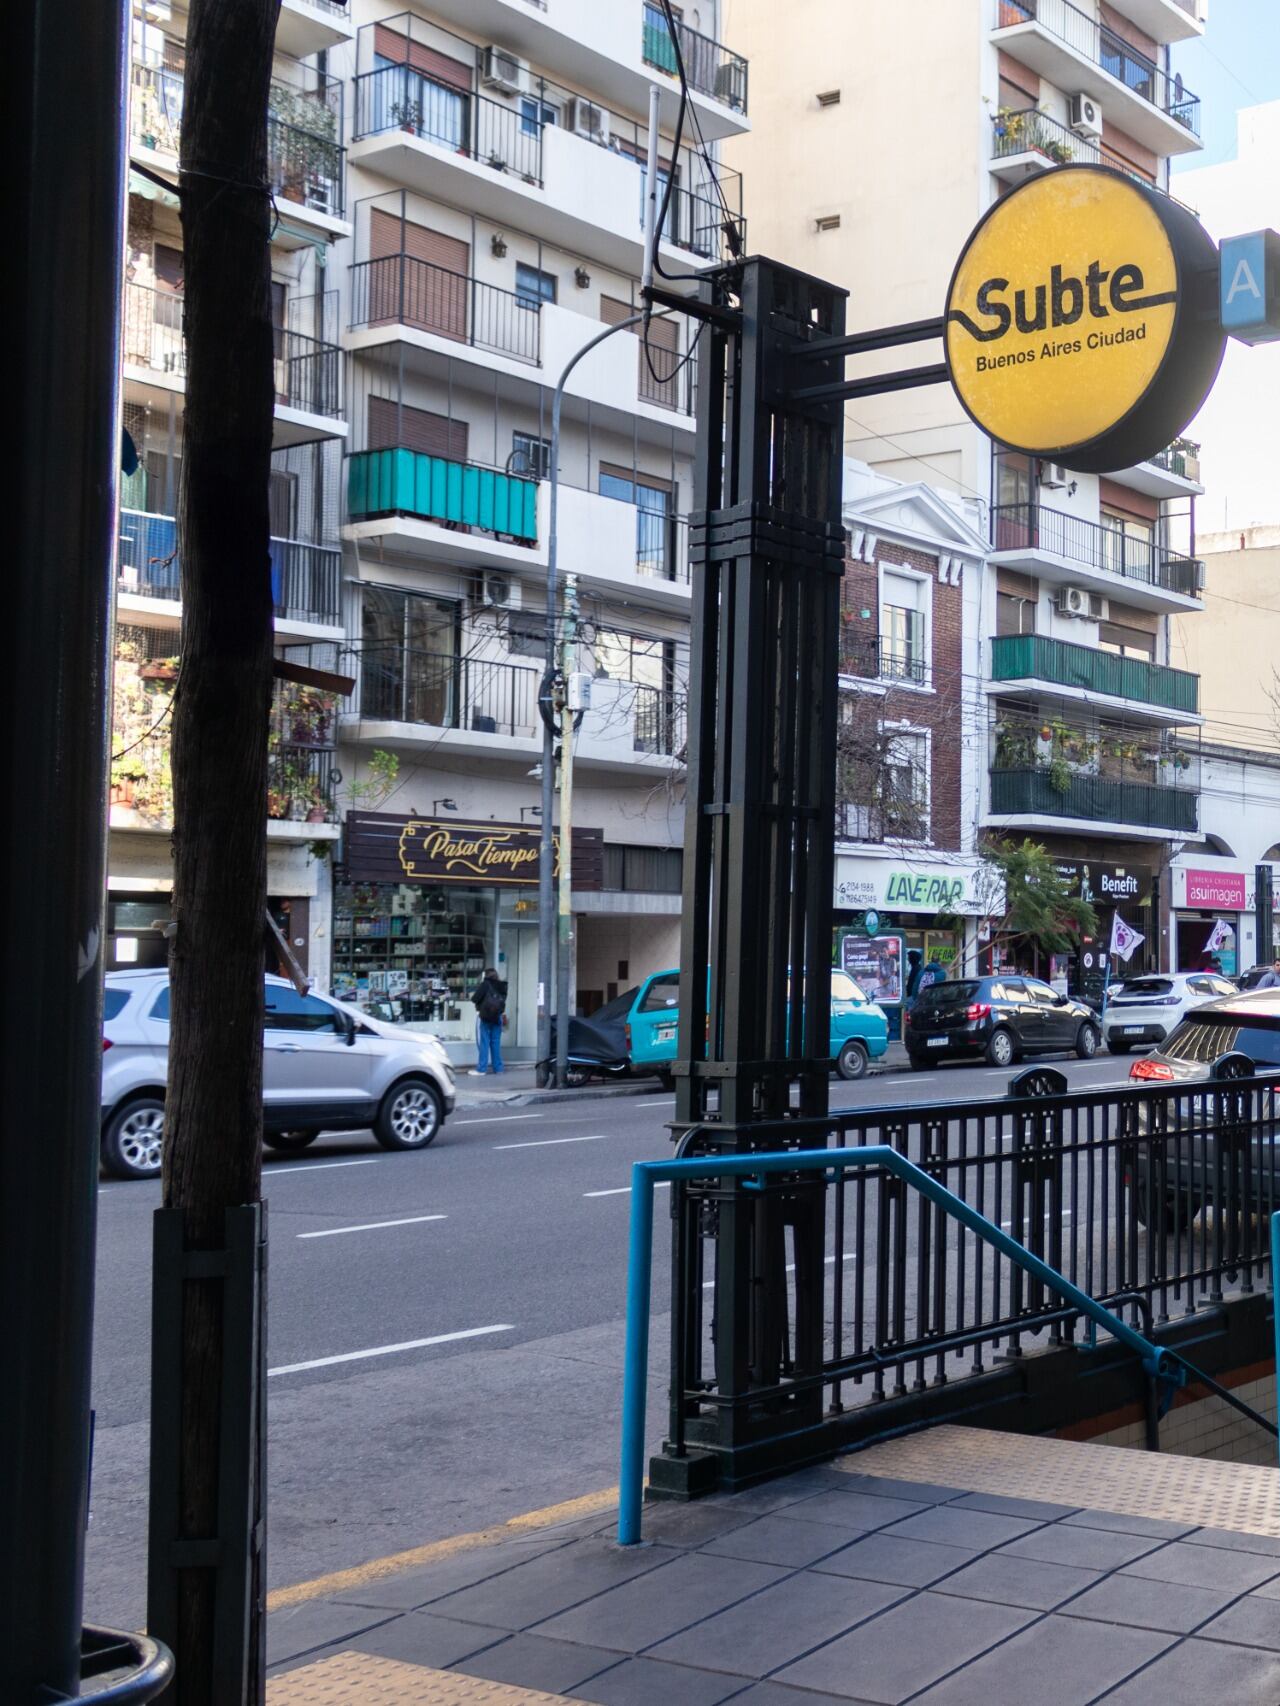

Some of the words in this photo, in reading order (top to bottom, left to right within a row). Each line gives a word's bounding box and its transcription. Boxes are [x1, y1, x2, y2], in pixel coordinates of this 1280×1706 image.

[974, 260, 1145, 343] Subte
[1226, 259, 1262, 305] A
[976, 348, 1036, 373] Buenos
[1040, 337, 1083, 360] Aires
[1086, 323, 1147, 350] Ciudad
[423, 830, 474, 859] Pasa
[472, 833, 539, 871] Tiempo
[1101, 874, 1138, 893] Benefit
[1190, 885, 1242, 906] asuimagen
